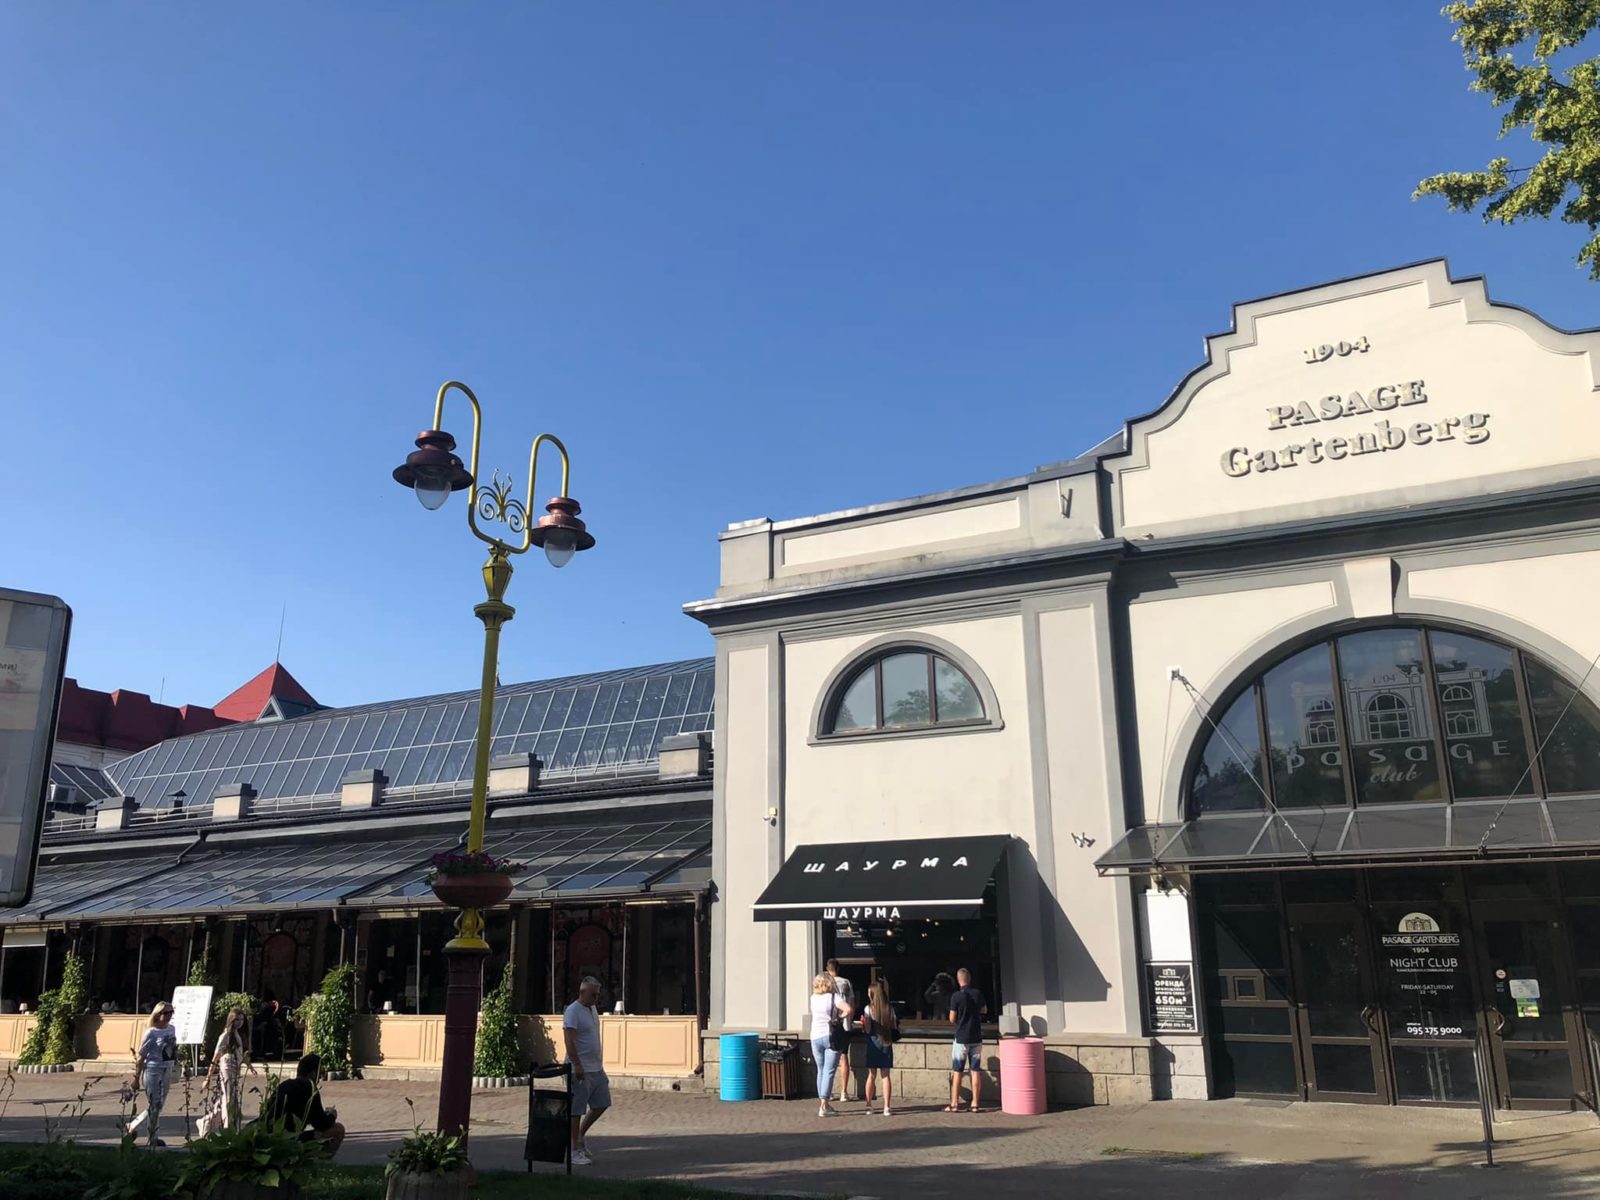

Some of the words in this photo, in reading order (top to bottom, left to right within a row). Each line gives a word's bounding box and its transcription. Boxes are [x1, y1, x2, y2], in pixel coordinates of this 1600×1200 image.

[1303, 335, 1370, 364] 1904
[1266, 379, 1428, 431] PASAGE
[1219, 411, 1491, 478] Gartenberg
[1369, 763, 1421, 784] club
[803, 856, 968, 873] ШАУРМА
[823, 906, 901, 919] ШАУРМА
[1382, 936, 1412, 944] PASAGE
[1412, 935, 1460, 944] GARTENBERG
[1390, 958, 1425, 968] NIGHT
[1427, 957, 1459, 968] CLUB
[1407, 1026, 1424, 1035] 095
[1440, 1027, 1462, 1036] 9000
